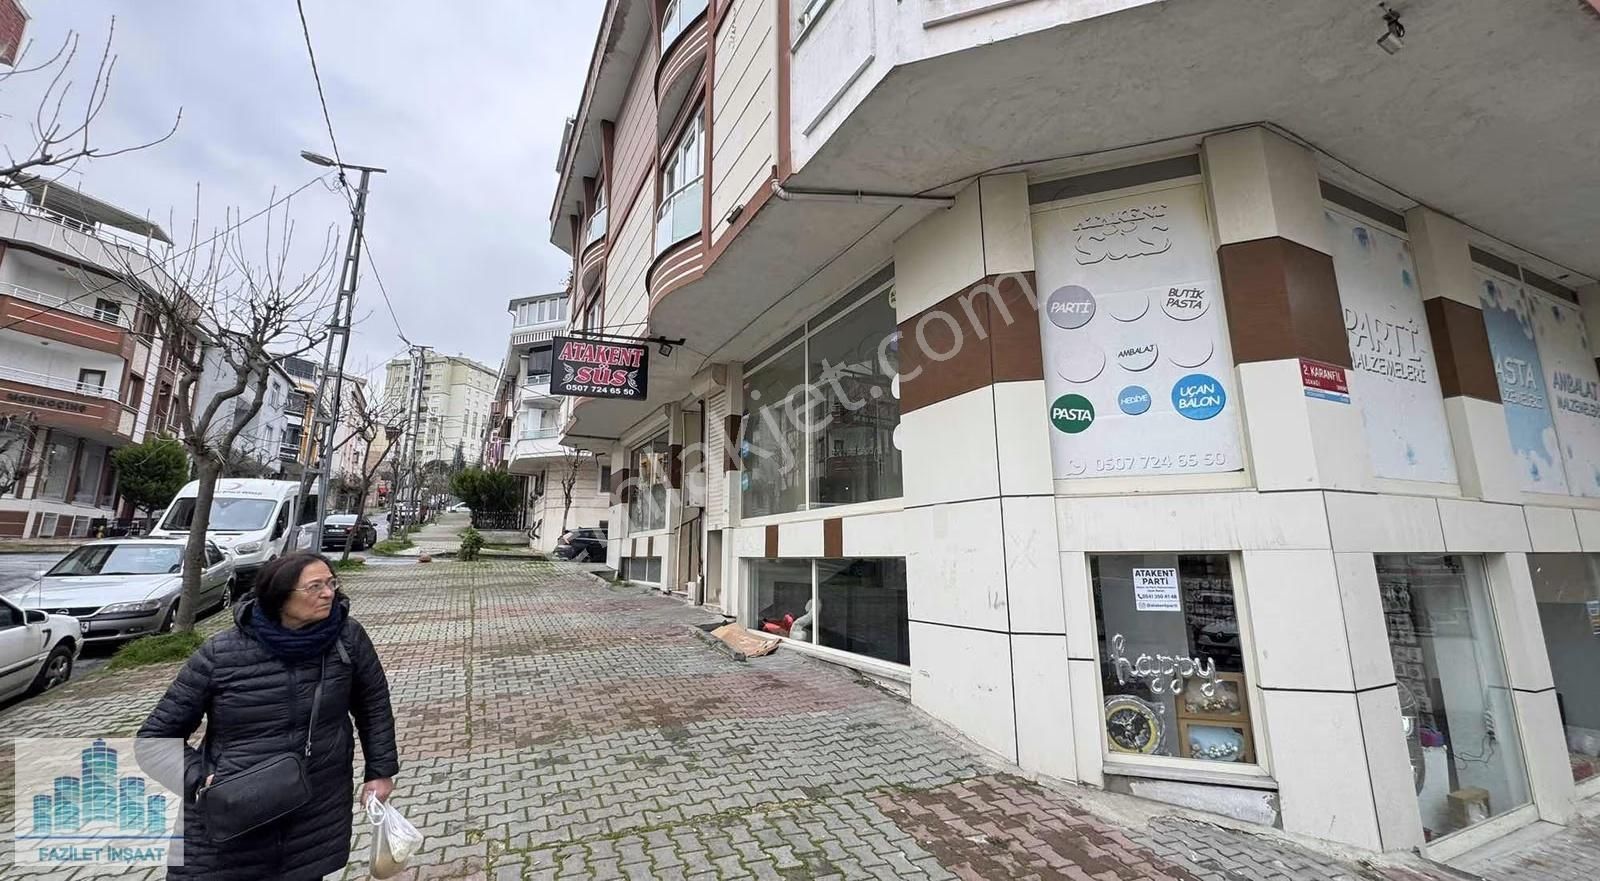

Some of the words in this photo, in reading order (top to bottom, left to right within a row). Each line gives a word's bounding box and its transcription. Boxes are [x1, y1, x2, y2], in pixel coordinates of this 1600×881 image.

[1168, 287, 1205, 300] BUTİK
[1166, 297, 1202, 309] PASTA
[558, 341, 645, 368] ATAKENT
[1117, 344, 1154, 358] AMBALAJ
[1494, 355, 1538, 392] ASTA
[565, 383, 589, 392] 0507
[591, 385, 608, 394] 724
[610, 387, 621, 395] 65
[623, 388, 635, 396] 50
[1180, 383, 1216, 398] UÇAN
[1178, 395, 1220, 409] BALON
[1052, 407, 1092, 423] PASTA
[1095, 457, 1136, 472] 0507
[1140, 455, 1173, 470] 724
[1135, 569, 1175, 577] ATAKENT
[1110, 632, 1223, 698] happy
